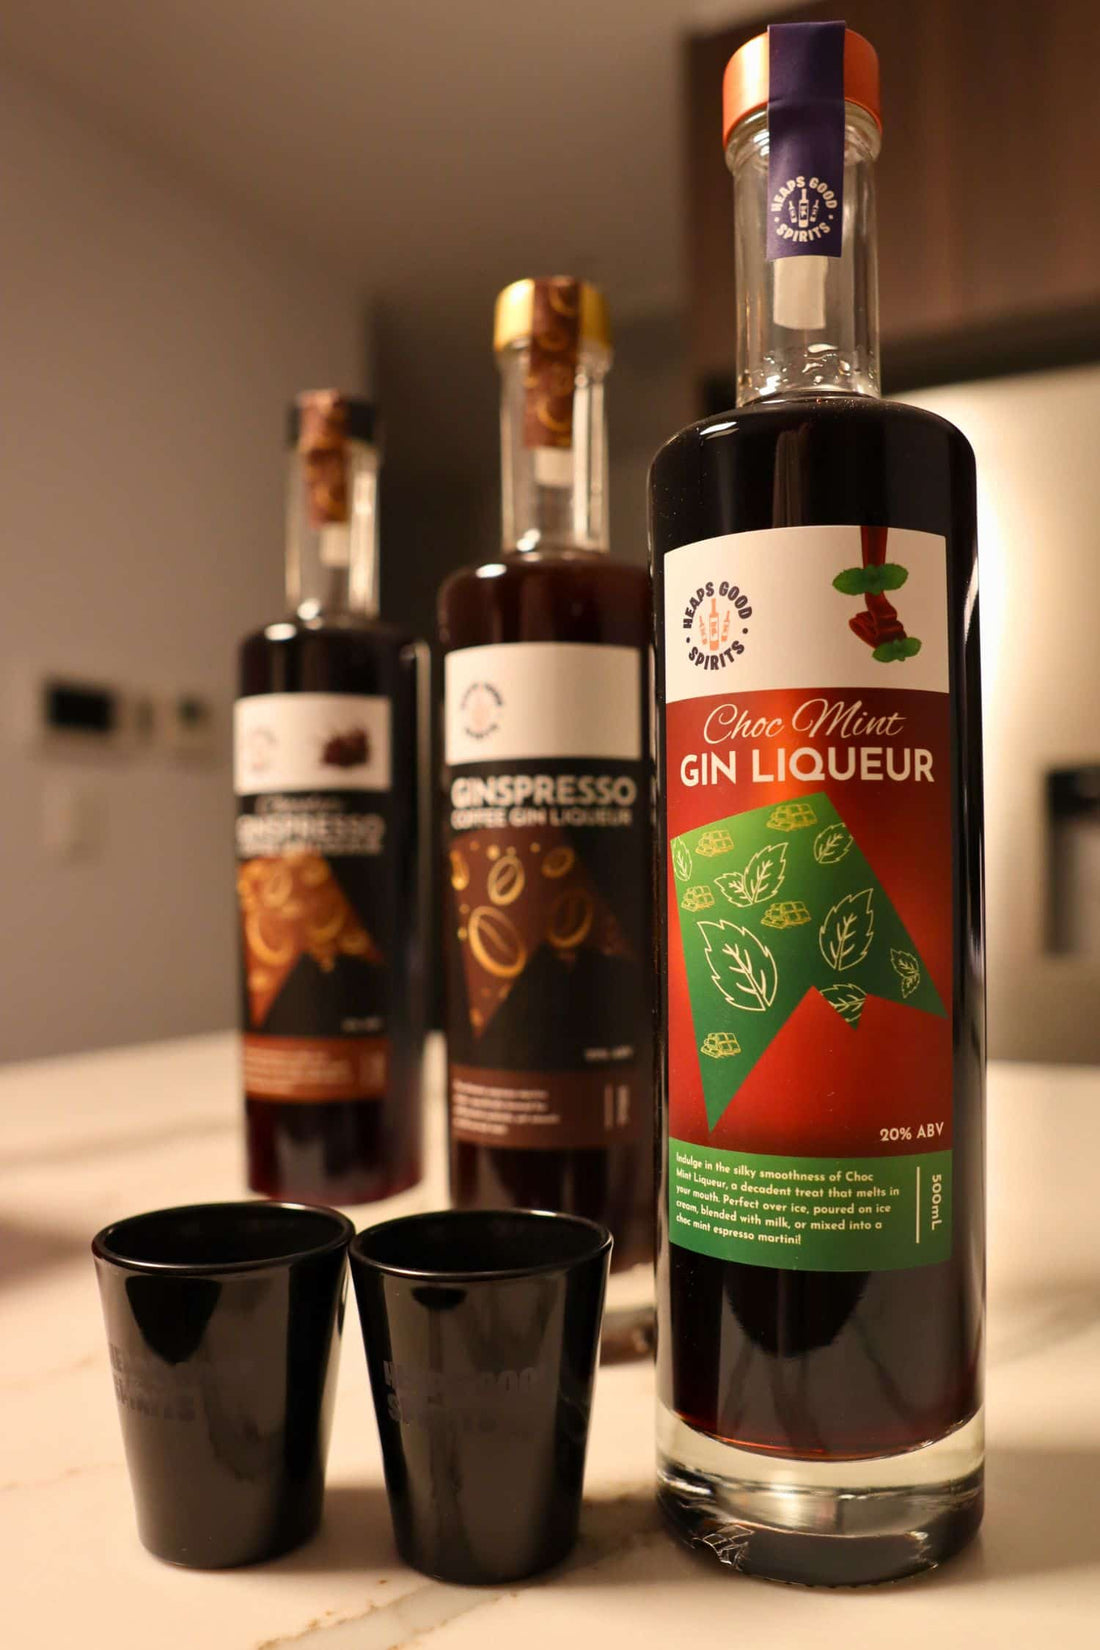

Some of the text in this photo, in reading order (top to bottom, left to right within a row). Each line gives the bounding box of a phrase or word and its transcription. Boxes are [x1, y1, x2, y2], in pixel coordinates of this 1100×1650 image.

[771, 176, 837, 212] HEAPS GOOD
[776, 222, 830, 242] SPIRITS
[683, 581, 753, 629] HEAPS GOOD
[688, 640, 745, 670] SPIRITS
[703, 698, 907, 745] Choc Mint
[680, 747, 935, 787] GIN LIQUEUR
[451, 775, 637, 808] GINSPRESSO
[880, 1122, 944, 1141] 20% ABV
[676, 1152, 874, 1182] Indulge in the silky smoothness of Choc
[676, 1168, 691, 1179] Mint
[694, 1174, 728, 1190] Liqueur,
[741, 1182, 790, 1195] decadent
[795, 1186, 824, 1198] treat
[828, 1187, 853, 1198] that
[856, 1186, 887, 1198] melts
[889, 1187, 900, 1196] in
[676, 1184, 692, 1196] your
[693, 1190, 720, 1202] mouth.
[723, 1194, 759, 1208] Perfect
[762, 1202, 787, 1212] over
[813, 1202, 855, 1216] poured
[875, 1203, 892, 1213] ice
[676, 1200, 883, 1230] cream, blended with milk, or mixed into a
[931, 1173, 943, 1231] 500mL
[676, 1213, 801, 1245] choc mint espresso martini!
